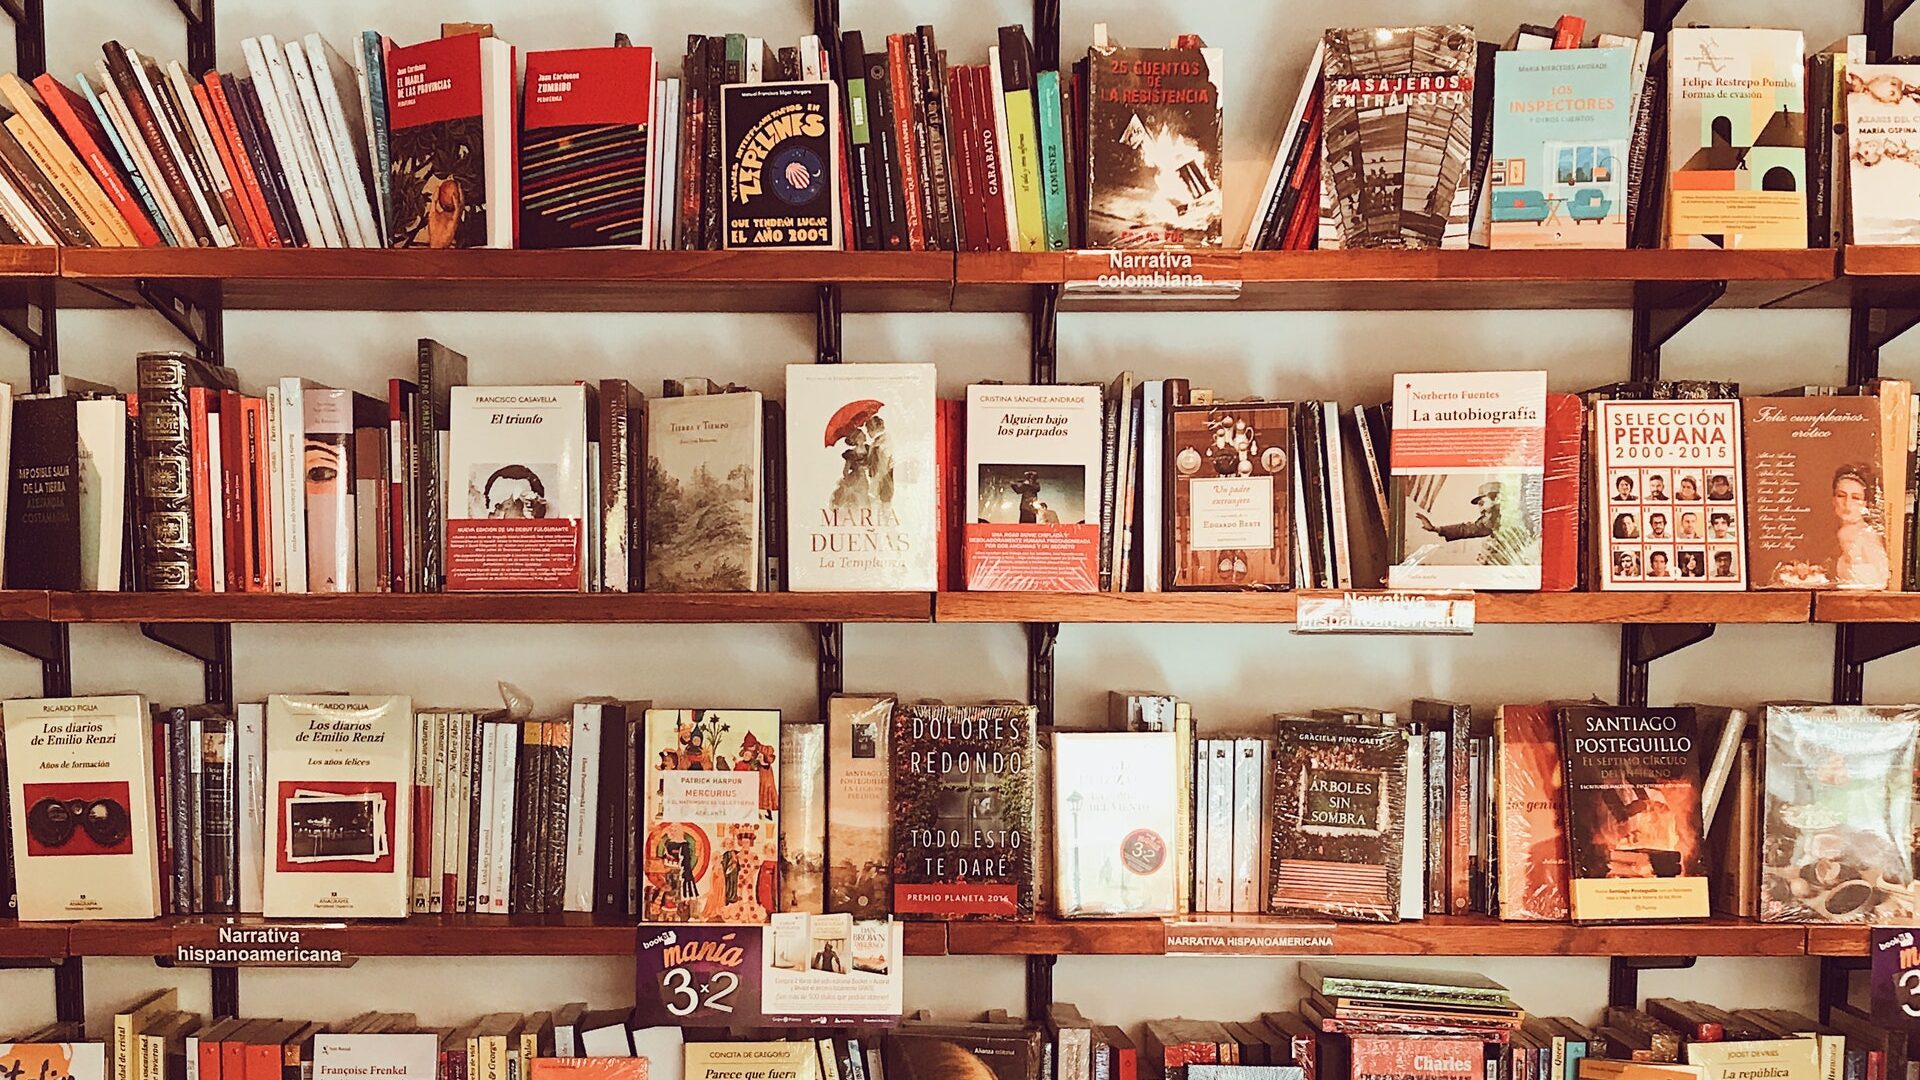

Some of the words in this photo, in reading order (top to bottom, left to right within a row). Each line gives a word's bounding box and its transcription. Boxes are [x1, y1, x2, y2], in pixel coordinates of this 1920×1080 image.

[1111, 60, 1128, 75] 25
[1133, 61, 1200, 76] CUENTOS
[537, 81, 571, 94] ZUMBIDO
[1147, 75, 1161, 88] DE
[1336, 75, 1460, 93] PASAJEROS
[1682, 77, 1714, 89] Felipe
[1715, 77, 1760, 89] Restrepo
[1762, 77, 1797, 88] Pombo
[397, 86, 406, 99] DE
[405, 83, 416, 97] LAS
[416, 79, 452, 95] PROVINCIAS
[1551, 85, 1574, 96] LOS
[1682, 90, 1715, 99] Formas
[1716, 90, 1728, 99] de
[1729, 89, 1763, 99] evasión
[1101, 88, 1119, 102] LA
[1123, 88, 1209, 104] RESISTENCIA
[807, 103, 820, 112] EN
[1509, 97, 1615, 113] INSPECTORES
[982, 129, 998, 196] GARABATO
[731, 218, 750, 228] QUE
[797, 216, 828, 227] LUGAR
[731, 229, 747, 243] EL
[753, 226, 783, 243] AÑO
[788, 228, 828, 243] 2009
[1109, 252, 1193, 269] Narrativa
[1097, 270, 1204, 288] colombiana
[475, 396, 517, 404] FRANCISCO
[518, 396, 557, 404] CASAVELLA
[979, 395, 1013, 403] CRISTINA
[1412, 391, 1459, 400] Norberto
[1460, 390, 1500, 400] Fuentes
[490, 413, 504, 425] El
[505, 413, 543, 425] triunfo
[1000, 413, 1044, 426] Alguien
[1044, 413, 1069, 427] bajo
[1412, 409, 1430, 422] La
[1434, 406, 1537, 425] autobiografía
[1614, 408, 1725, 426] SELECCIÓN
[1752, 405, 1788, 423] Feliz
[997, 425, 1014, 436] los
[1614, 426, 1727, 445] PERUANA
[1791, 426, 1833, 438] erótico
[22, 483, 33, 494] DE
[34, 482, 44, 494] LA
[1228, 484, 1251, 497] padre
[809, 528, 911, 553] DUEÑAS
[819, 556, 835, 568] La
[1343, 591, 1426, 609] Narrativa
[43, 705, 77, 713] RICARDO
[76, 704, 99, 712] PIGLIA
[346, 703, 369, 711] PIGLIA
[43, 722, 63, 734] Los
[65, 722, 103, 733] diarios
[308, 719, 331, 731] Los
[332, 720, 372, 731] diarios
[912, 717, 1021, 741] DOLORES
[1586, 716, 1677, 732] SANTIAGO
[30, 735, 45, 746] de
[47, 734, 83, 745] Emilio
[85, 733, 117, 745] Renzi
[295, 731, 311, 742] de
[312, 731, 350, 742] Emilio
[352, 731, 386, 743] Renzi
[1338, 736, 1358, 744] PINO
[1358, 738, 1385, 746] GAETE
[1574, 736, 1692, 754] POSTEGUILLO
[60, 761, 70, 769] de
[308, 757, 323, 765] Los
[911, 751, 1022, 776] REDONDO
[1582, 756, 1593, 767] EL
[1642, 754, 1688, 766] CÍRCULO
[681, 777, 711, 785] PATRICK
[712, 777, 743, 785] HARPUR
[1308, 774, 1373, 796] ÁRBOLES
[685, 789, 738, 798] MERCURIUS
[1457, 783, 1468, 815] SIERRA
[1328, 796, 1351, 809] SIN
[1310, 810, 1368, 826] SOMBRA
[1458, 815, 1468, 848] JAVIER
[910, 829, 961, 849] TODO
[973, 829, 1021, 849] ESTO
[924, 857, 945, 877] TE
[958, 853, 1007, 877] DARÉ
[907, 893, 943, 903] PREMIO
[944, 893, 988, 903] PLANETA
[218, 927, 301, 943] Narrativa
[861, 926, 876, 935] DAN
[853, 933, 887, 945] BROWN
[1167, 936, 1227, 947] NARRATIVA
[1230, 936, 1334, 947] HISPANOAMERICANA
[177, 945, 343, 965] hispanoamericana
[663, 932, 745, 969] manía
[117, 1026, 127, 1052] cristal
[488, 1040, 498, 1071] George
[523, 1038, 533, 1060] Pulso
[709, 1051, 743, 1059] CONCITA
[743, 1051, 752, 1059] DE
[753, 1051, 791, 1059] GREGORIO
[974, 1047, 995, 1055] Alianza
[117, 1052, 127, 1064] de
[150, 1042, 159, 1076] invierno
[1412, 1054, 1473, 1072] Charles
[320, 1064, 368, 1077] Françoise
[369, 1064, 408, 1076] Frenkel
[705, 1069, 743, 1080] Parece
[744, 1070, 766, 1080] que
[767, 1068, 797, 1080] fuera
[1722, 1069, 1736, 1080] La
[1738, 1067, 1790, 1080] república
